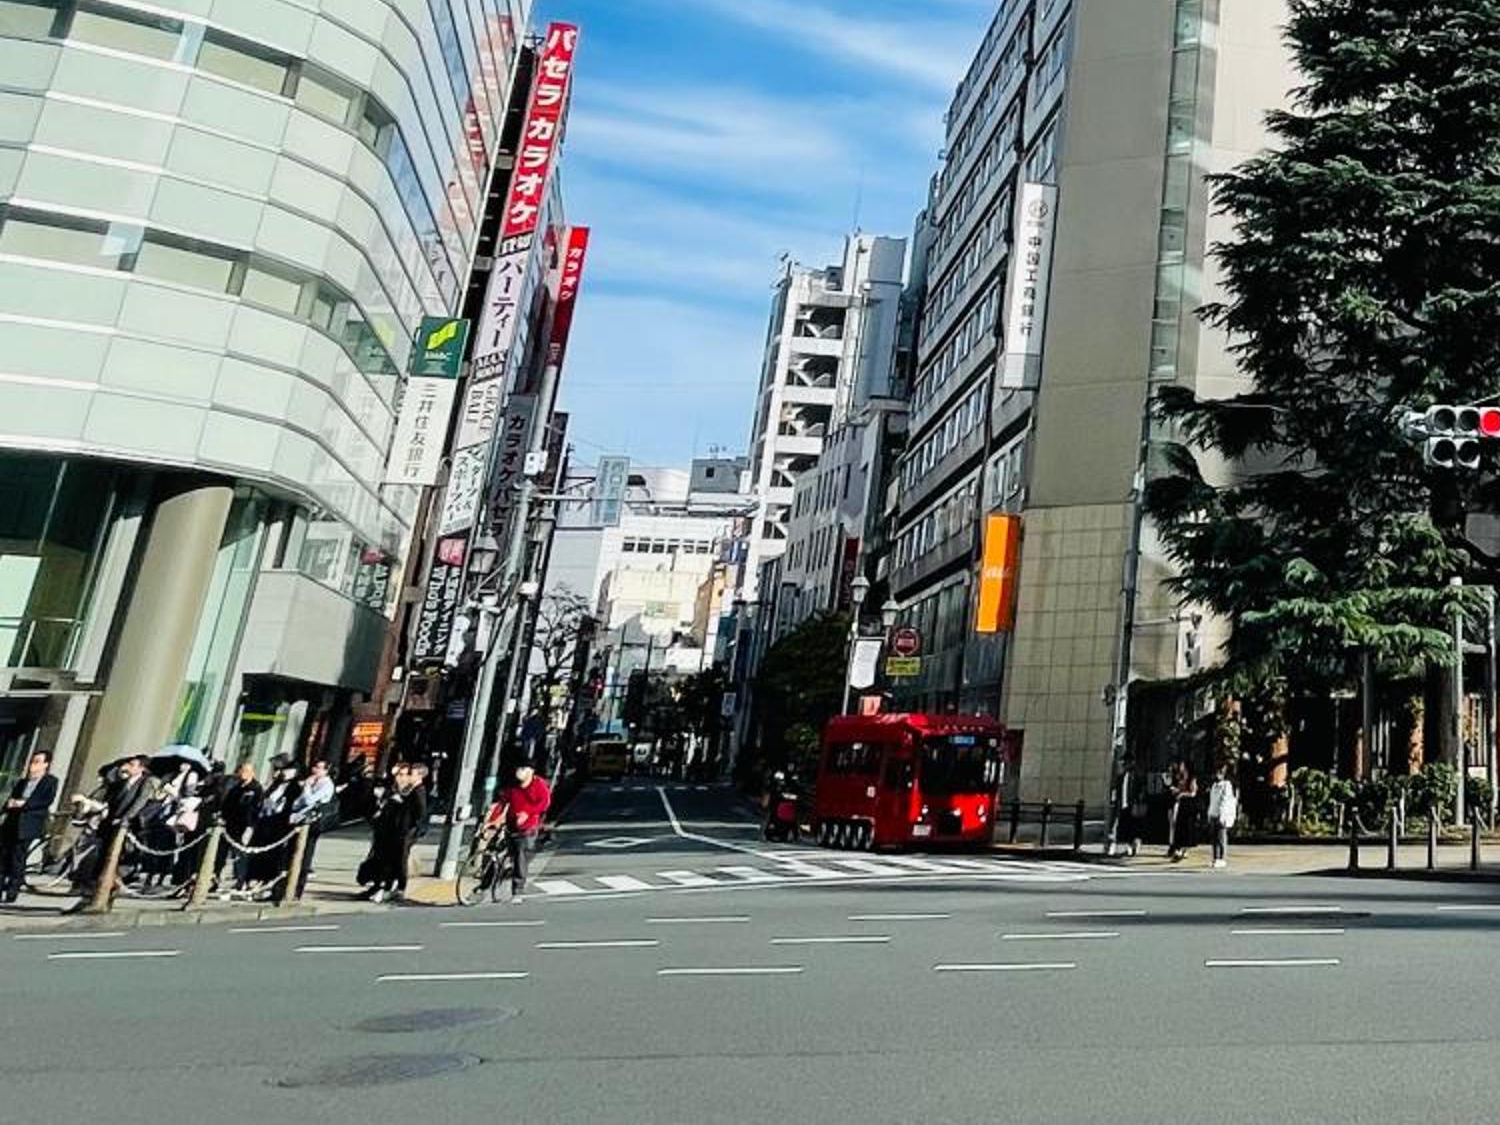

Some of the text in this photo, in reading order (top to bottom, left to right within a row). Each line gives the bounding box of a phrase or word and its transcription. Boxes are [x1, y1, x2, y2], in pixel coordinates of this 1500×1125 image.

[491, 256, 524, 348] パーティー
